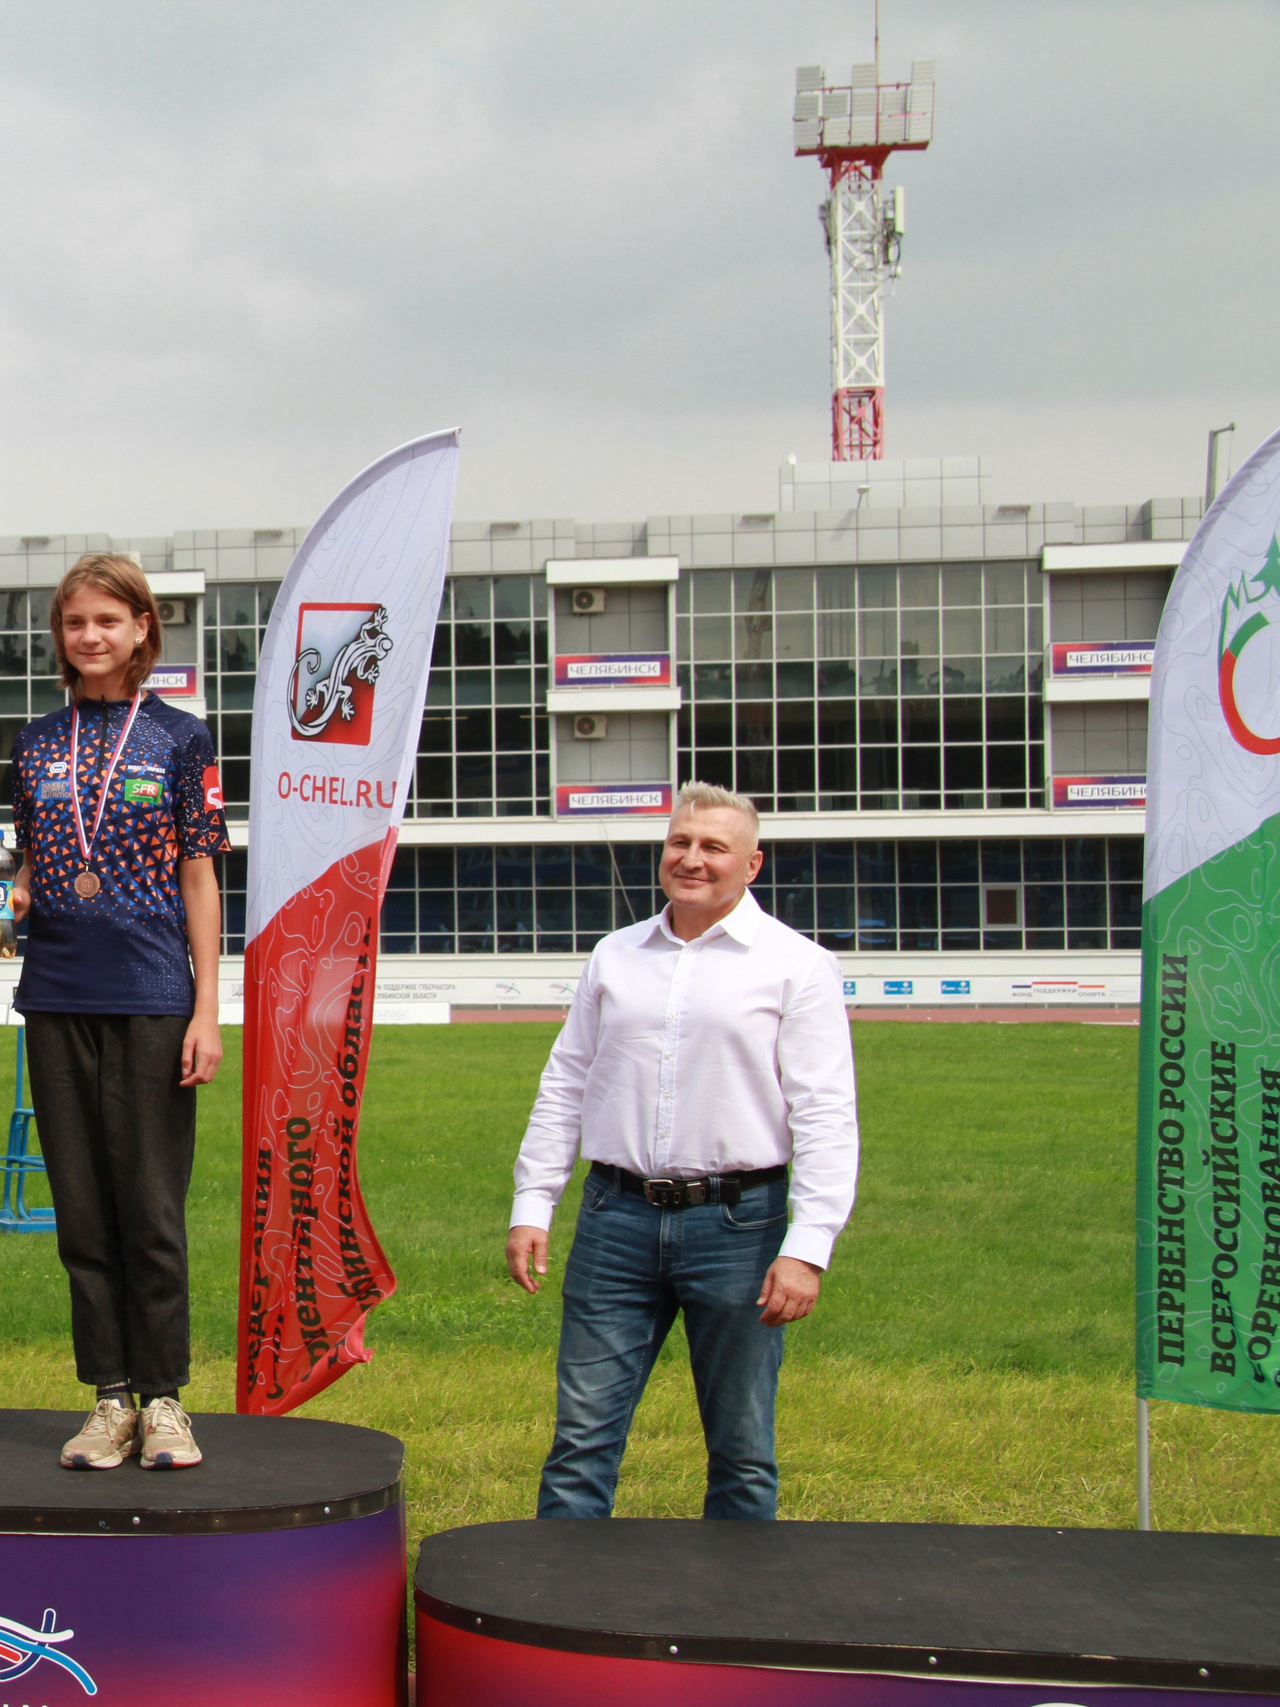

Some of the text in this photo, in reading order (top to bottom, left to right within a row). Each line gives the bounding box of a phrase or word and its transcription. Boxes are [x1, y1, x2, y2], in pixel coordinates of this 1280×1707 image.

[1069, 652, 1153, 664] ЧЕЛЯБИНС
[570, 664, 658, 675] ЧЕЛЯБИНСК
[132, 783, 156, 795] SFR
[277, 771, 397, 809] O-CHEL.RU
[1070, 786, 1147, 797] ЧЕЛЯБИН
[571, 793, 660, 805] ЧЕЛЯБИНСК
[1157, 953, 1189, 1368] ПЕРВЕНСТВО РОССИИ
[1201, 1041, 1240, 1377] ВСЕРОССИЙСКИЕ
